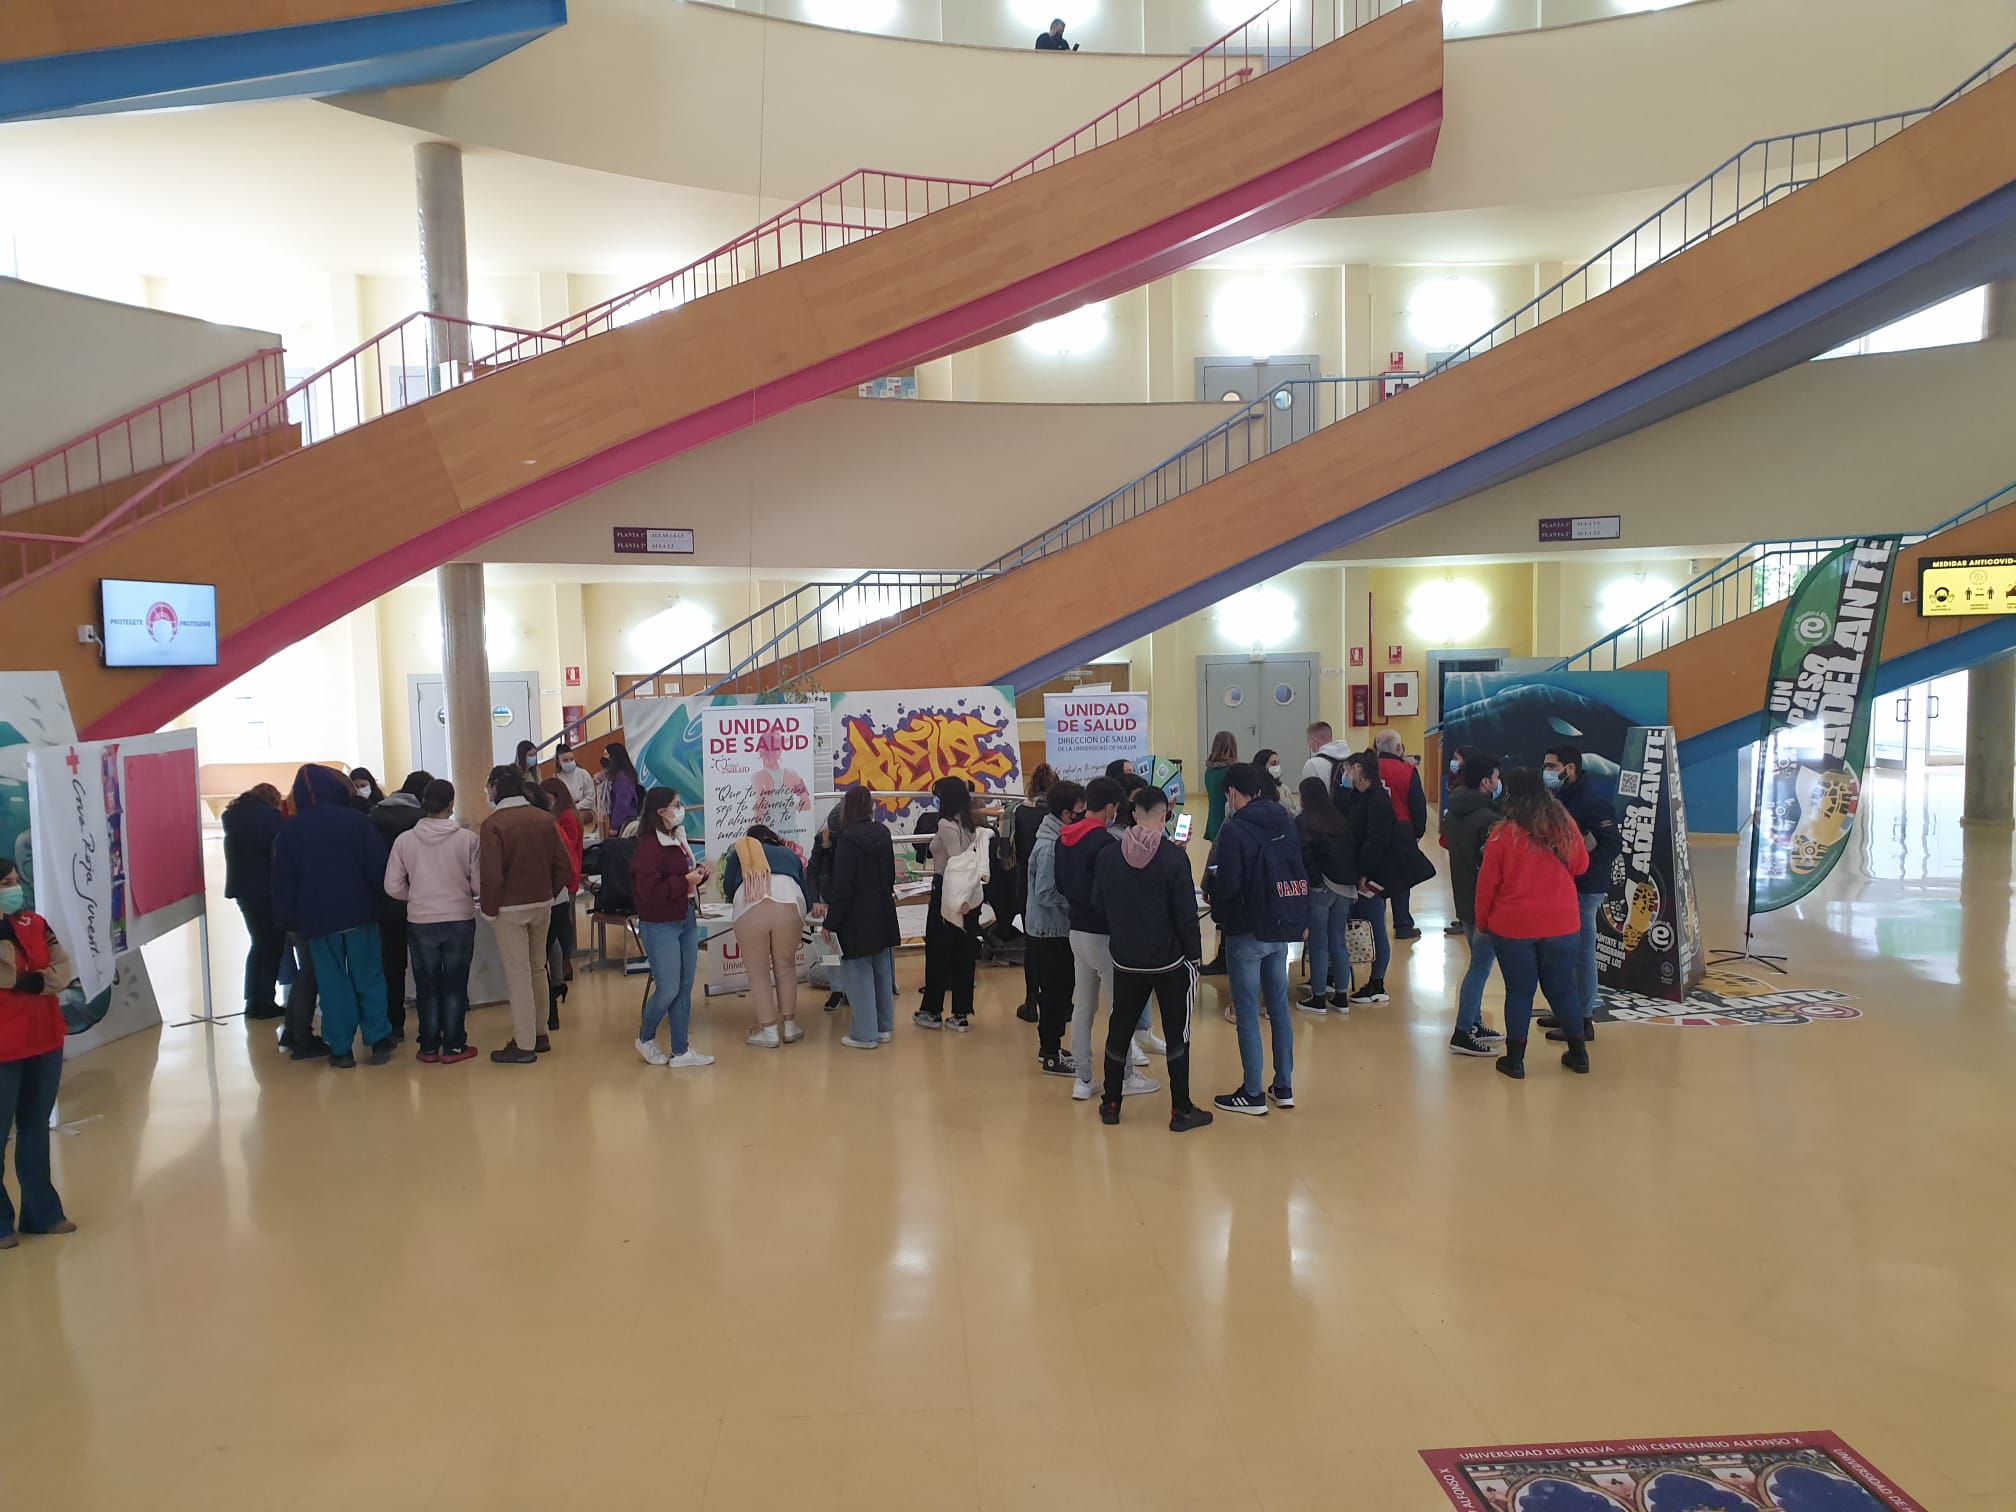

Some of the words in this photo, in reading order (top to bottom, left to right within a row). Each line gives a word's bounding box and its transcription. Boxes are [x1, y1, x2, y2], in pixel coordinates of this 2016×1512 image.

[1932, 560, 1967, 568] MEDIDAS
[1817, 538, 1894, 760] ADELANTE
[1769, 680, 1794, 711] UN
[1786, 652, 1830, 728] PASO
[1064, 703, 1129, 717] UNIDAD
[718, 717, 800, 735] UNIDAD
[1057, 719, 1079, 733] DE
[1084, 718, 1137, 732] SALUD
[710, 737, 738, 755] DE
[744, 734, 809, 753] SALUD
[1100, 736, 1110, 744] DE
[1111, 735, 1137, 743] SALUD
[744, 784, 757, 800] tu
[1631, 728, 1666, 876] ADELANTE
[715, 805, 732, 815] sea
[736, 800, 748, 814] tu
[752, 796, 795, 811] alimento
[716, 812, 728, 827] el
[780, 810, 791, 823] tu
[1276, 879, 1308, 898] VANS
[1607, 989, 1849, 1021] ADELANTE
[1459, 1449, 1543, 1461] UNIVERSIDAD
[1545, 1448, 1563, 1456] DE
[1566, 1445, 1616, 1455] HUELVA
[1626, 1443, 1649, 1452] VIII
[1650, 1440, 1731, 1451] CENTENARIO
[1733, 1436, 1791, 1447] ALFONSO
[1791, 1436, 1804, 1445] X
[1832, 1448, 1892, 1495] UNIVERSIDAD
[1888, 1495, 1909, 1508] DE
[1443, 1475, 1475, 1509] ALFONSO
